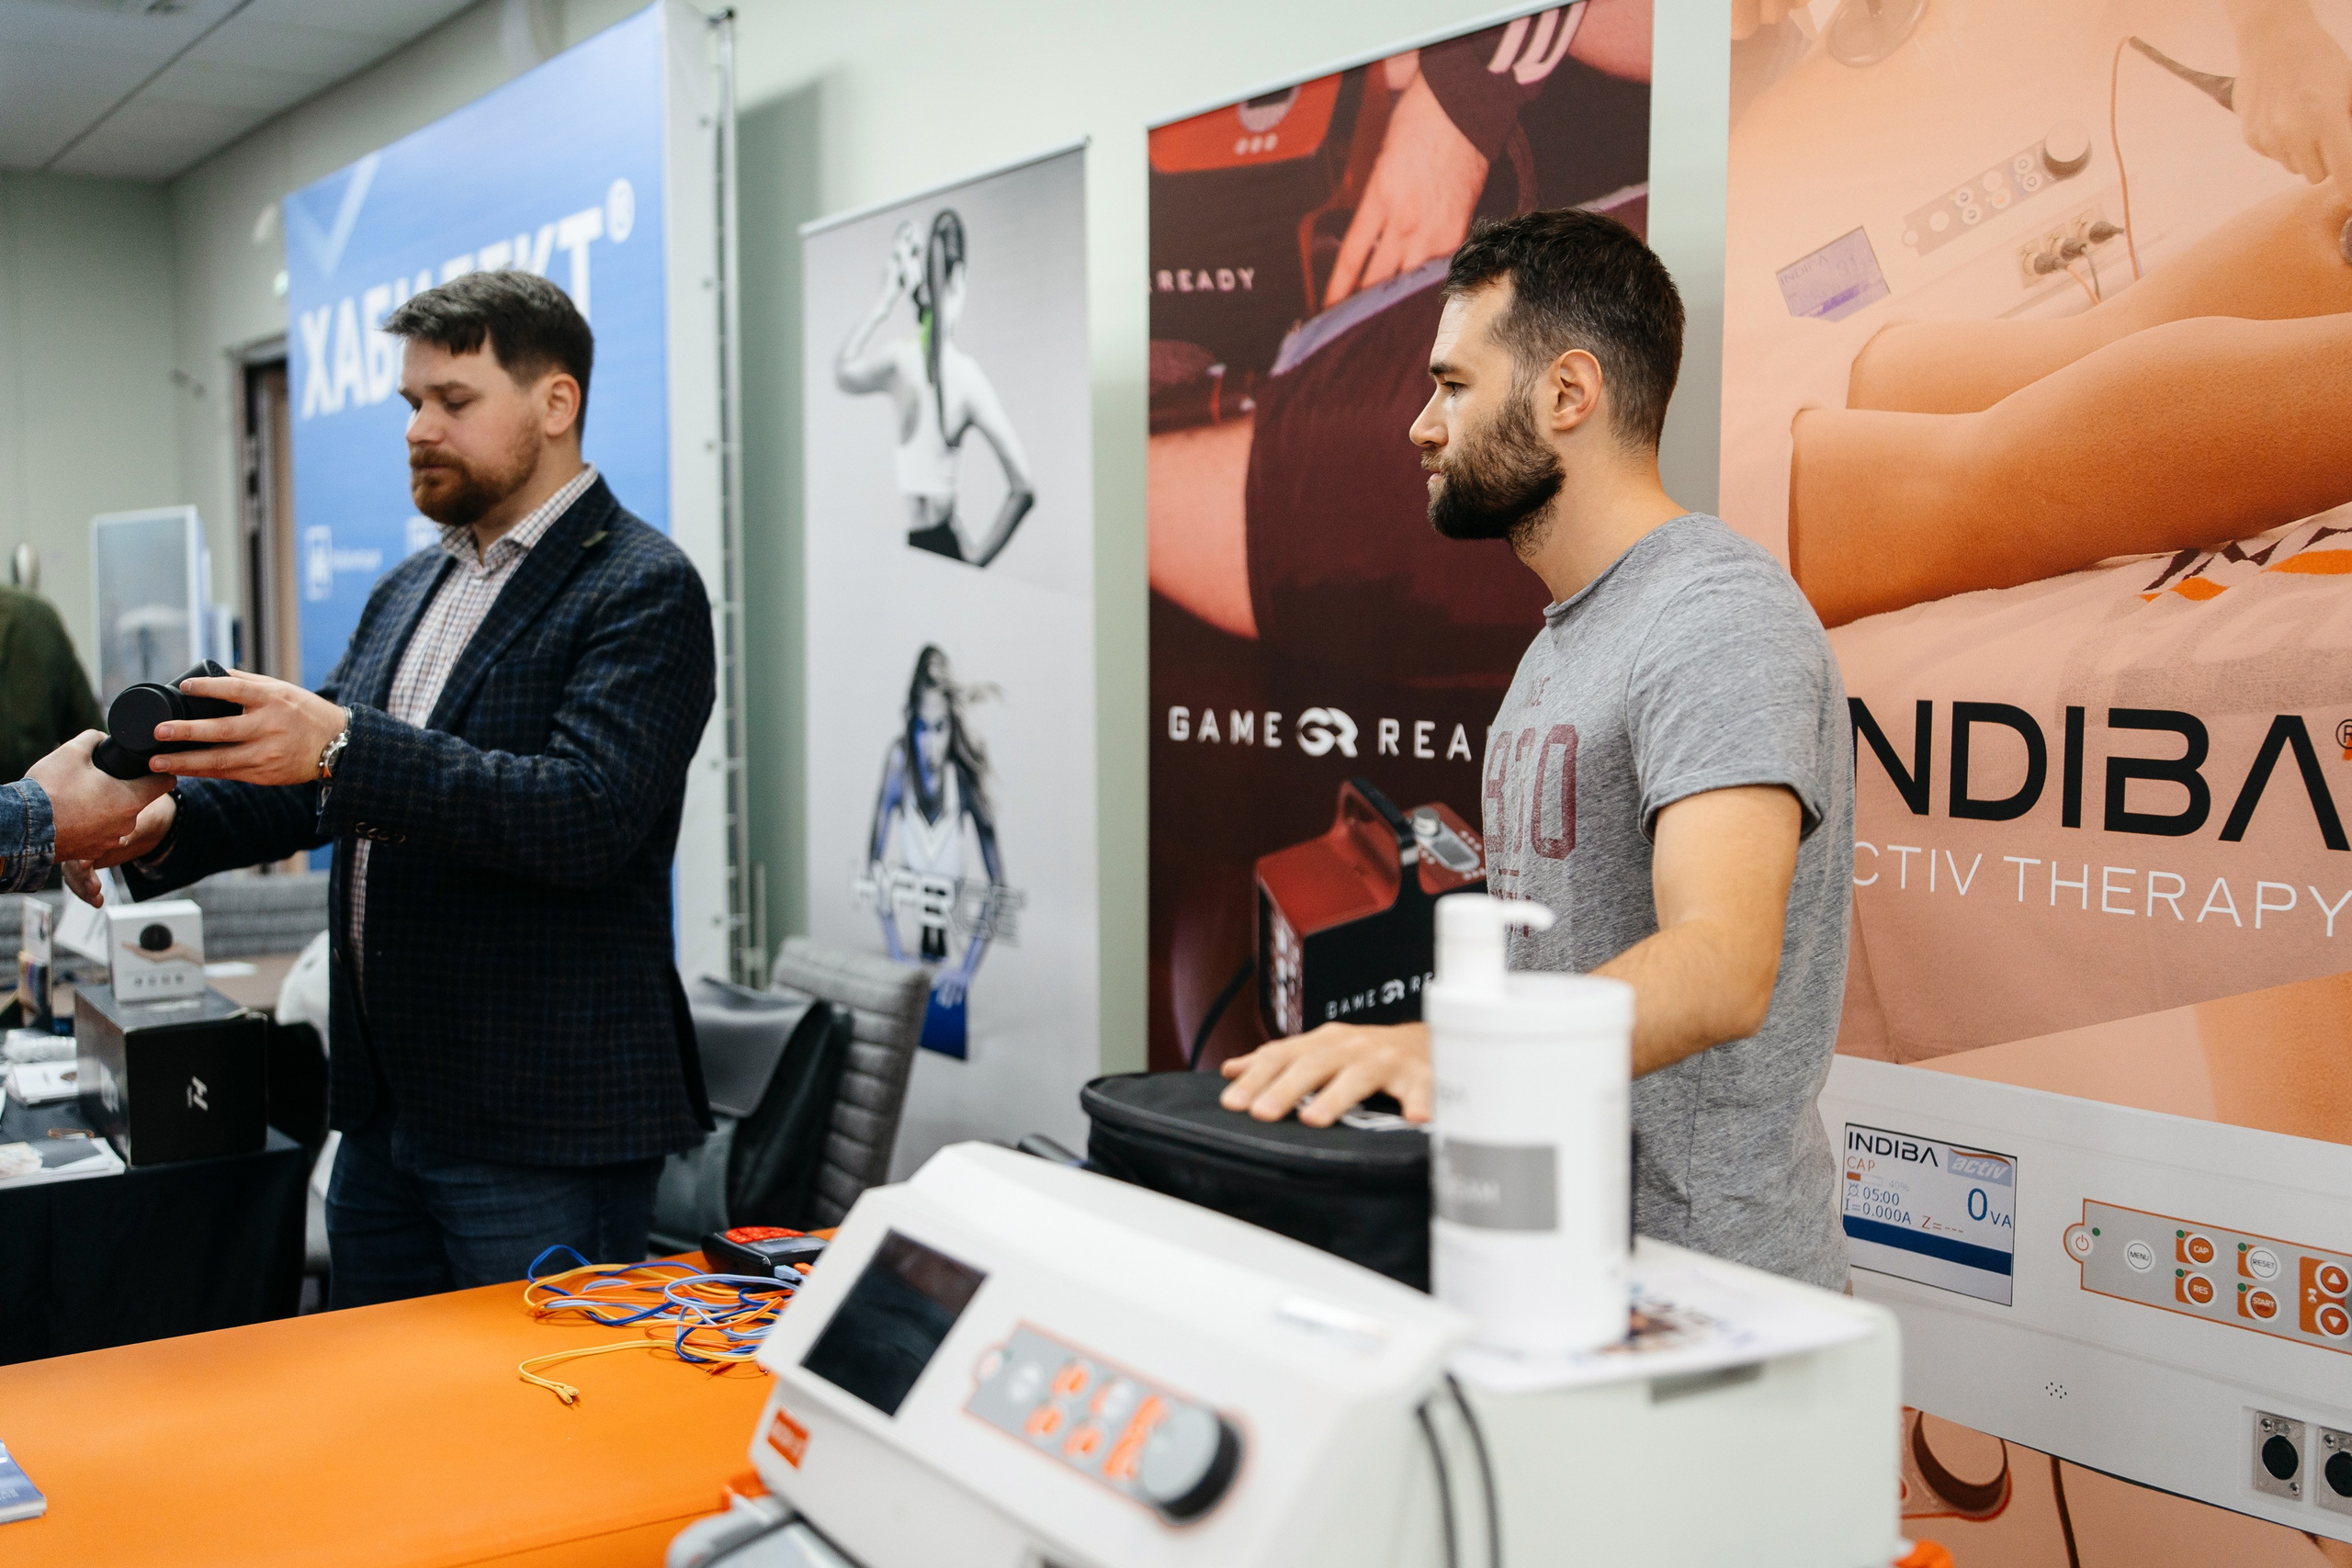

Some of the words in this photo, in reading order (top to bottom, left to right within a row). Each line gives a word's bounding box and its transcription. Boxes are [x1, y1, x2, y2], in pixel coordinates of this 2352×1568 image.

[1156, 266, 1254, 293] READY
[1168, 705, 1283, 748] GAME
[1378, 717, 1491, 761] REA
[1851, 840, 1983, 897] CTIV
[2003, 855, 2352, 937] THERAPY
[1325, 988, 1376, 1020] GAME
[1847, 1156, 1875, 1172] CAP
[1849, 1131, 1939, 1168] INDIBA
[1951, 1156, 2009, 1180] activ
[1888, 1179, 1910, 1192] 40%
[1862, 1186, 1900, 1206] 05:00
[1967, 1188, 1988, 1221] 0
[1990, 1211, 2012, 1229] VA
[2130, 1251, 2150, 1262] MENU
[2193, 1245, 2210, 1255] CAP
[2252, 1258, 2276, 1269] RESET
[2193, 1284, 2209, 1295] RES
[2252, 1296, 2276, 1308] START
